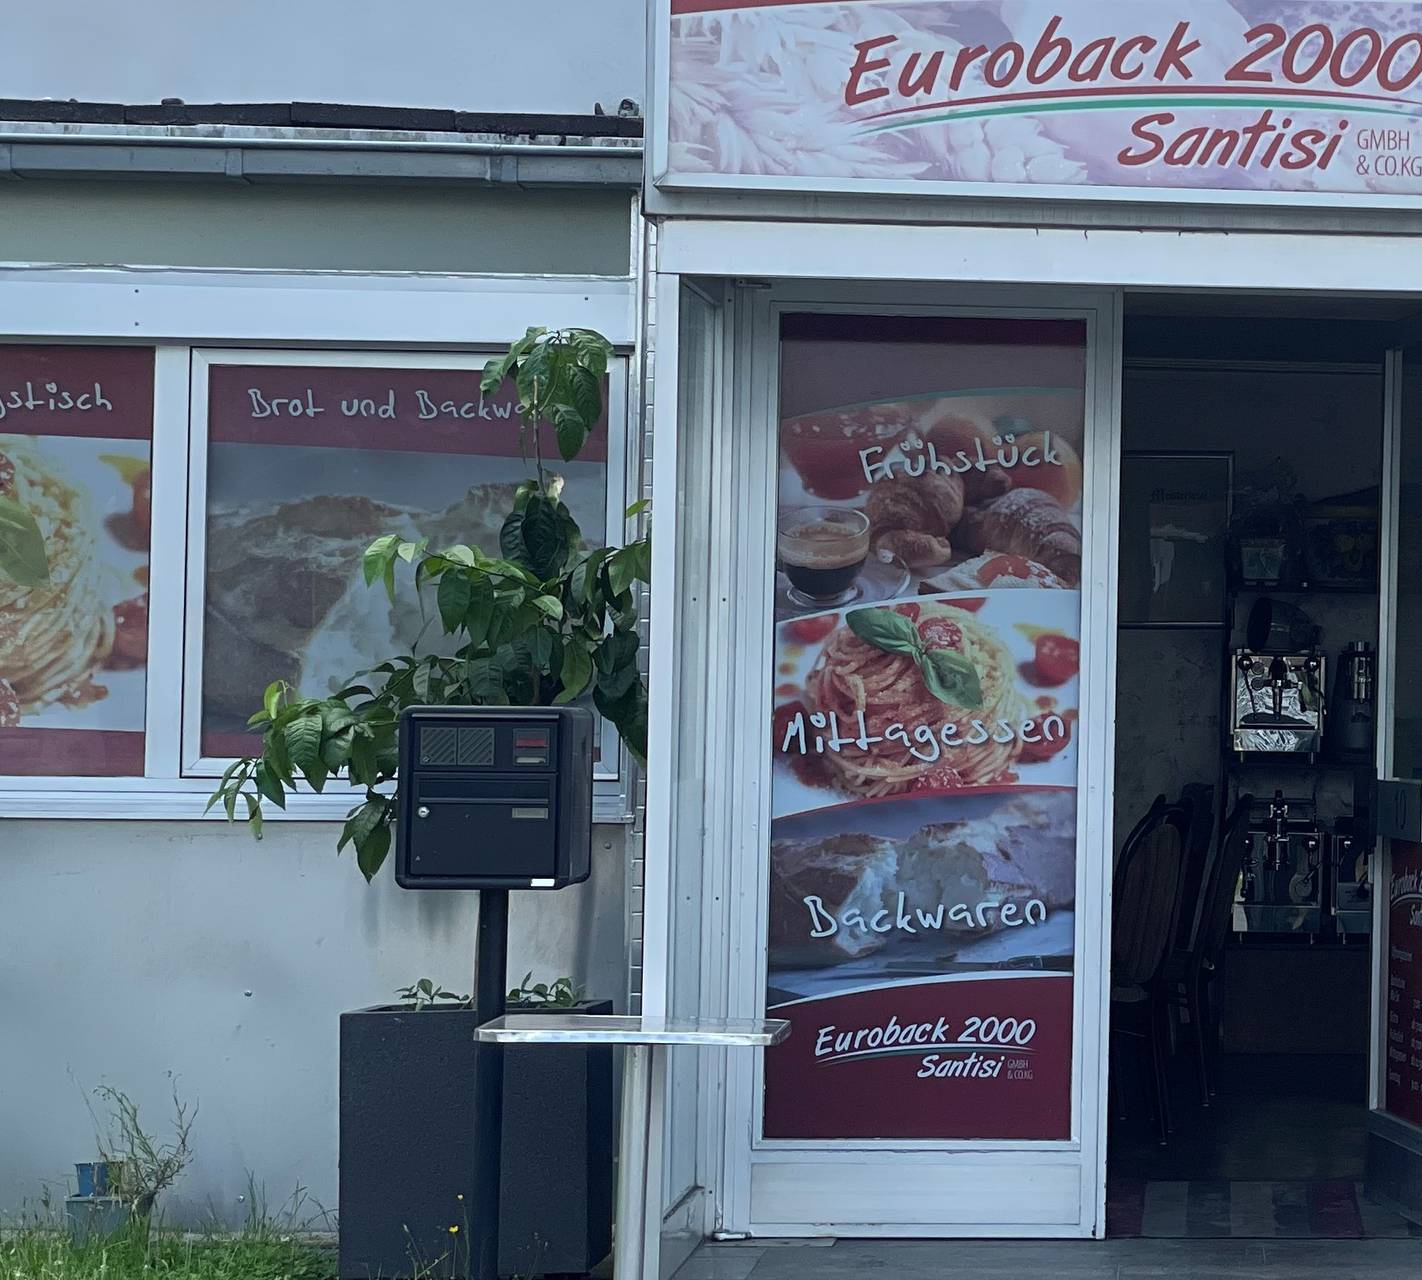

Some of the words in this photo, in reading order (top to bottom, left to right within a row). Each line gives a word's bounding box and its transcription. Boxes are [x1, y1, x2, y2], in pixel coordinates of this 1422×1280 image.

[845, 16, 1203, 107] Euroback
[1116, 109, 1351, 170] Santisi
[1357, 128, 1410, 150] GMBH
[1356, 154, 1370, 176] &
[1374, 155, 1422, 177] CO.KG
[249, 389, 325, 418] Brot
[341, 391, 397, 419] und
[417, 391, 529, 421] Backwa
[858, 430, 1064, 484] Frühstück
[781, 709, 1066, 762] Mittagessen
[804, 891, 1047, 938] Backwaren
[815, 1016, 950, 1057] Euroback
[957, 1016, 1038, 1046] 2000
[916, 1053, 1006, 1079] Santisi
